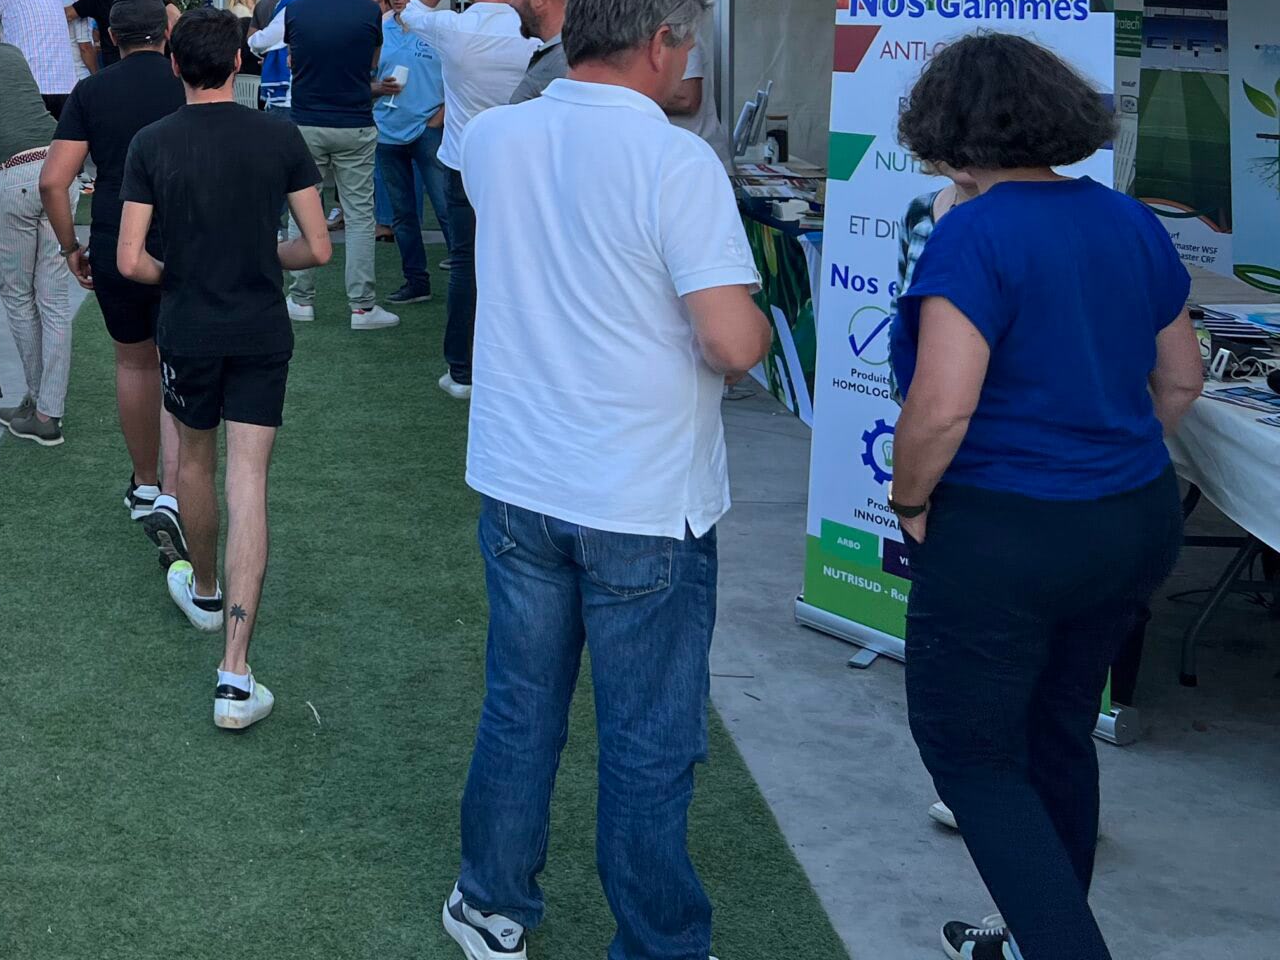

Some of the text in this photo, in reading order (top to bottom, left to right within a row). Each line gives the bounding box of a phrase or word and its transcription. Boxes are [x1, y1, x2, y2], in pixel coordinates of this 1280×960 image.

[849, 215, 870, 235] ET
[830, 263, 879, 295] Nos
[837, 536, 861, 550] ARBO
[823, 564, 882, 593] NUTRISUD
